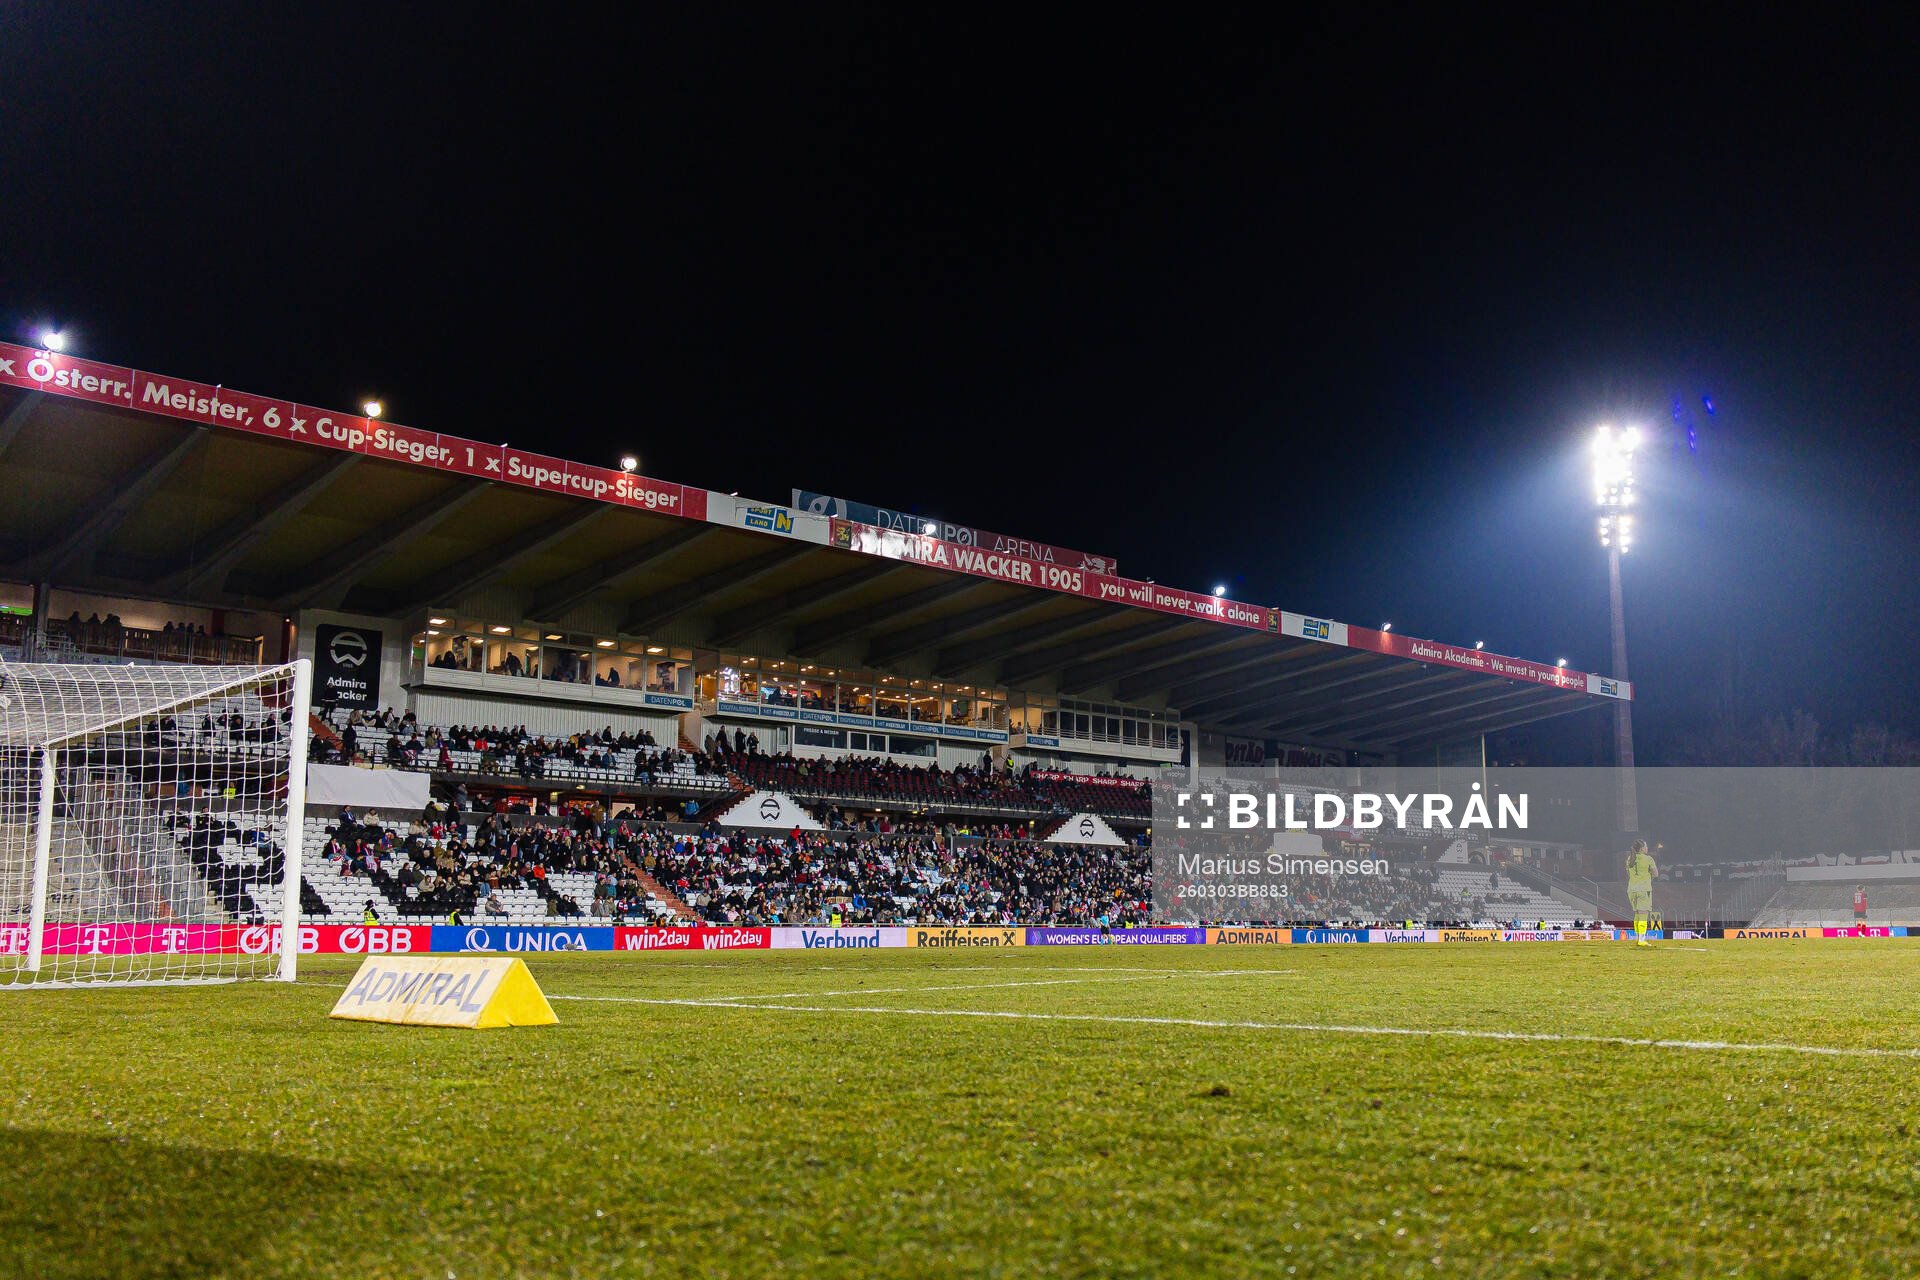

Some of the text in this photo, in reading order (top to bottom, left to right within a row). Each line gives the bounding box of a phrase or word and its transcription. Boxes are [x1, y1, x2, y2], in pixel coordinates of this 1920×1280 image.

[27, 350, 132, 399] Österr.
[142, 381, 254, 426] Meister,
[262, 407, 281, 428] 6
[289, 417, 308, 434] x
[315, 417, 454, 466] Cup-Sieger,
[465, 447, 475, 467] 1
[484, 455, 500, 473] x
[508, 456, 678, 509] Supercup-Sieger
[750, 517, 769, 527] LAND
[993, 536, 1056, 564] ARENA
[953, 547, 1033, 582] WACKER
[1039, 566, 1083, 593] 1905
[1100, 582, 1260, 624] you will never walk alone
[1411, 642, 1443, 660] Admira
[1444, 649, 1485, 668] Akademie
[1491, 658, 1504, 672] We
[1505, 661, 1527, 677] invest
[1528, 666, 1536, 678] in
[1538, 670, 1560, 686] young
[1561, 672, 1585, 688] people
[326, 676, 367, 689] Admira
[336, 690, 367, 701] acker
[650, 696, 686, 707] DATENPOL
[803, 713, 833, 722] DATENPOL
[912, 724, 940, 734] DATENPOL
[1092, 778, 1118, 786] SHARP
[505, 931, 587, 951] UNIQA
[625, 929, 762, 950] win2day win2day
[801, 929, 880, 949] Verbund
[917, 930, 999, 947] Raiffeisen
[1046, 933, 1187, 945] WOMEN'S EURPEAN QUALIFIERS
[1512, 932, 1559, 941] INTERSPORT
[340, 967, 490, 1013] ADMIRAL
